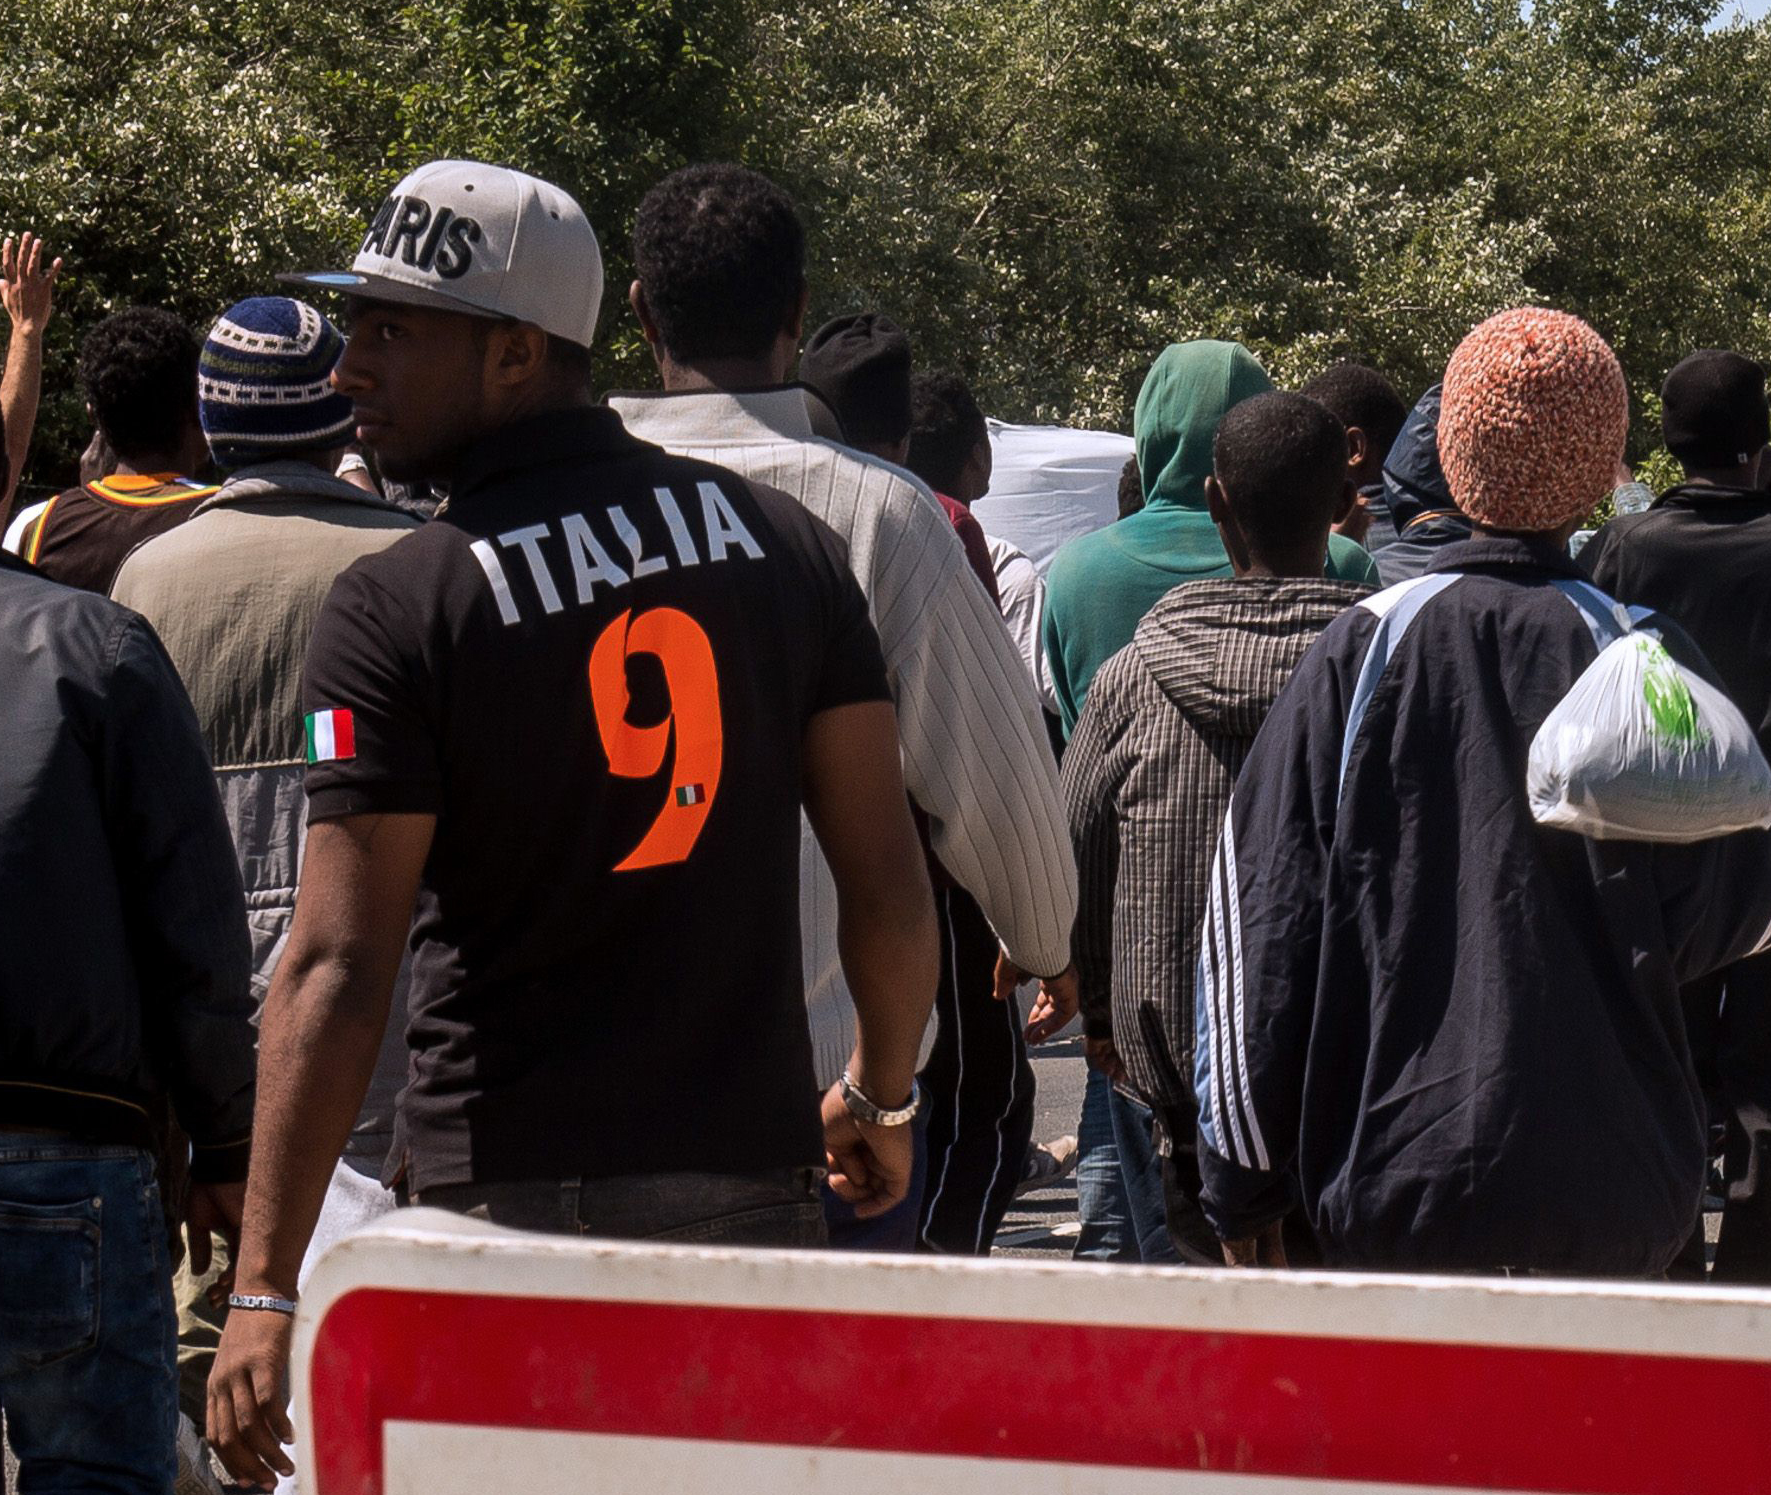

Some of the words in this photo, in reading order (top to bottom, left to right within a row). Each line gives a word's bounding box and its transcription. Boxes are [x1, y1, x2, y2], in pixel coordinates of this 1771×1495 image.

[361, 195, 482, 279] ARIS
[469, 480, 765, 626] ITALIA
[588, 607, 722, 873] 9
